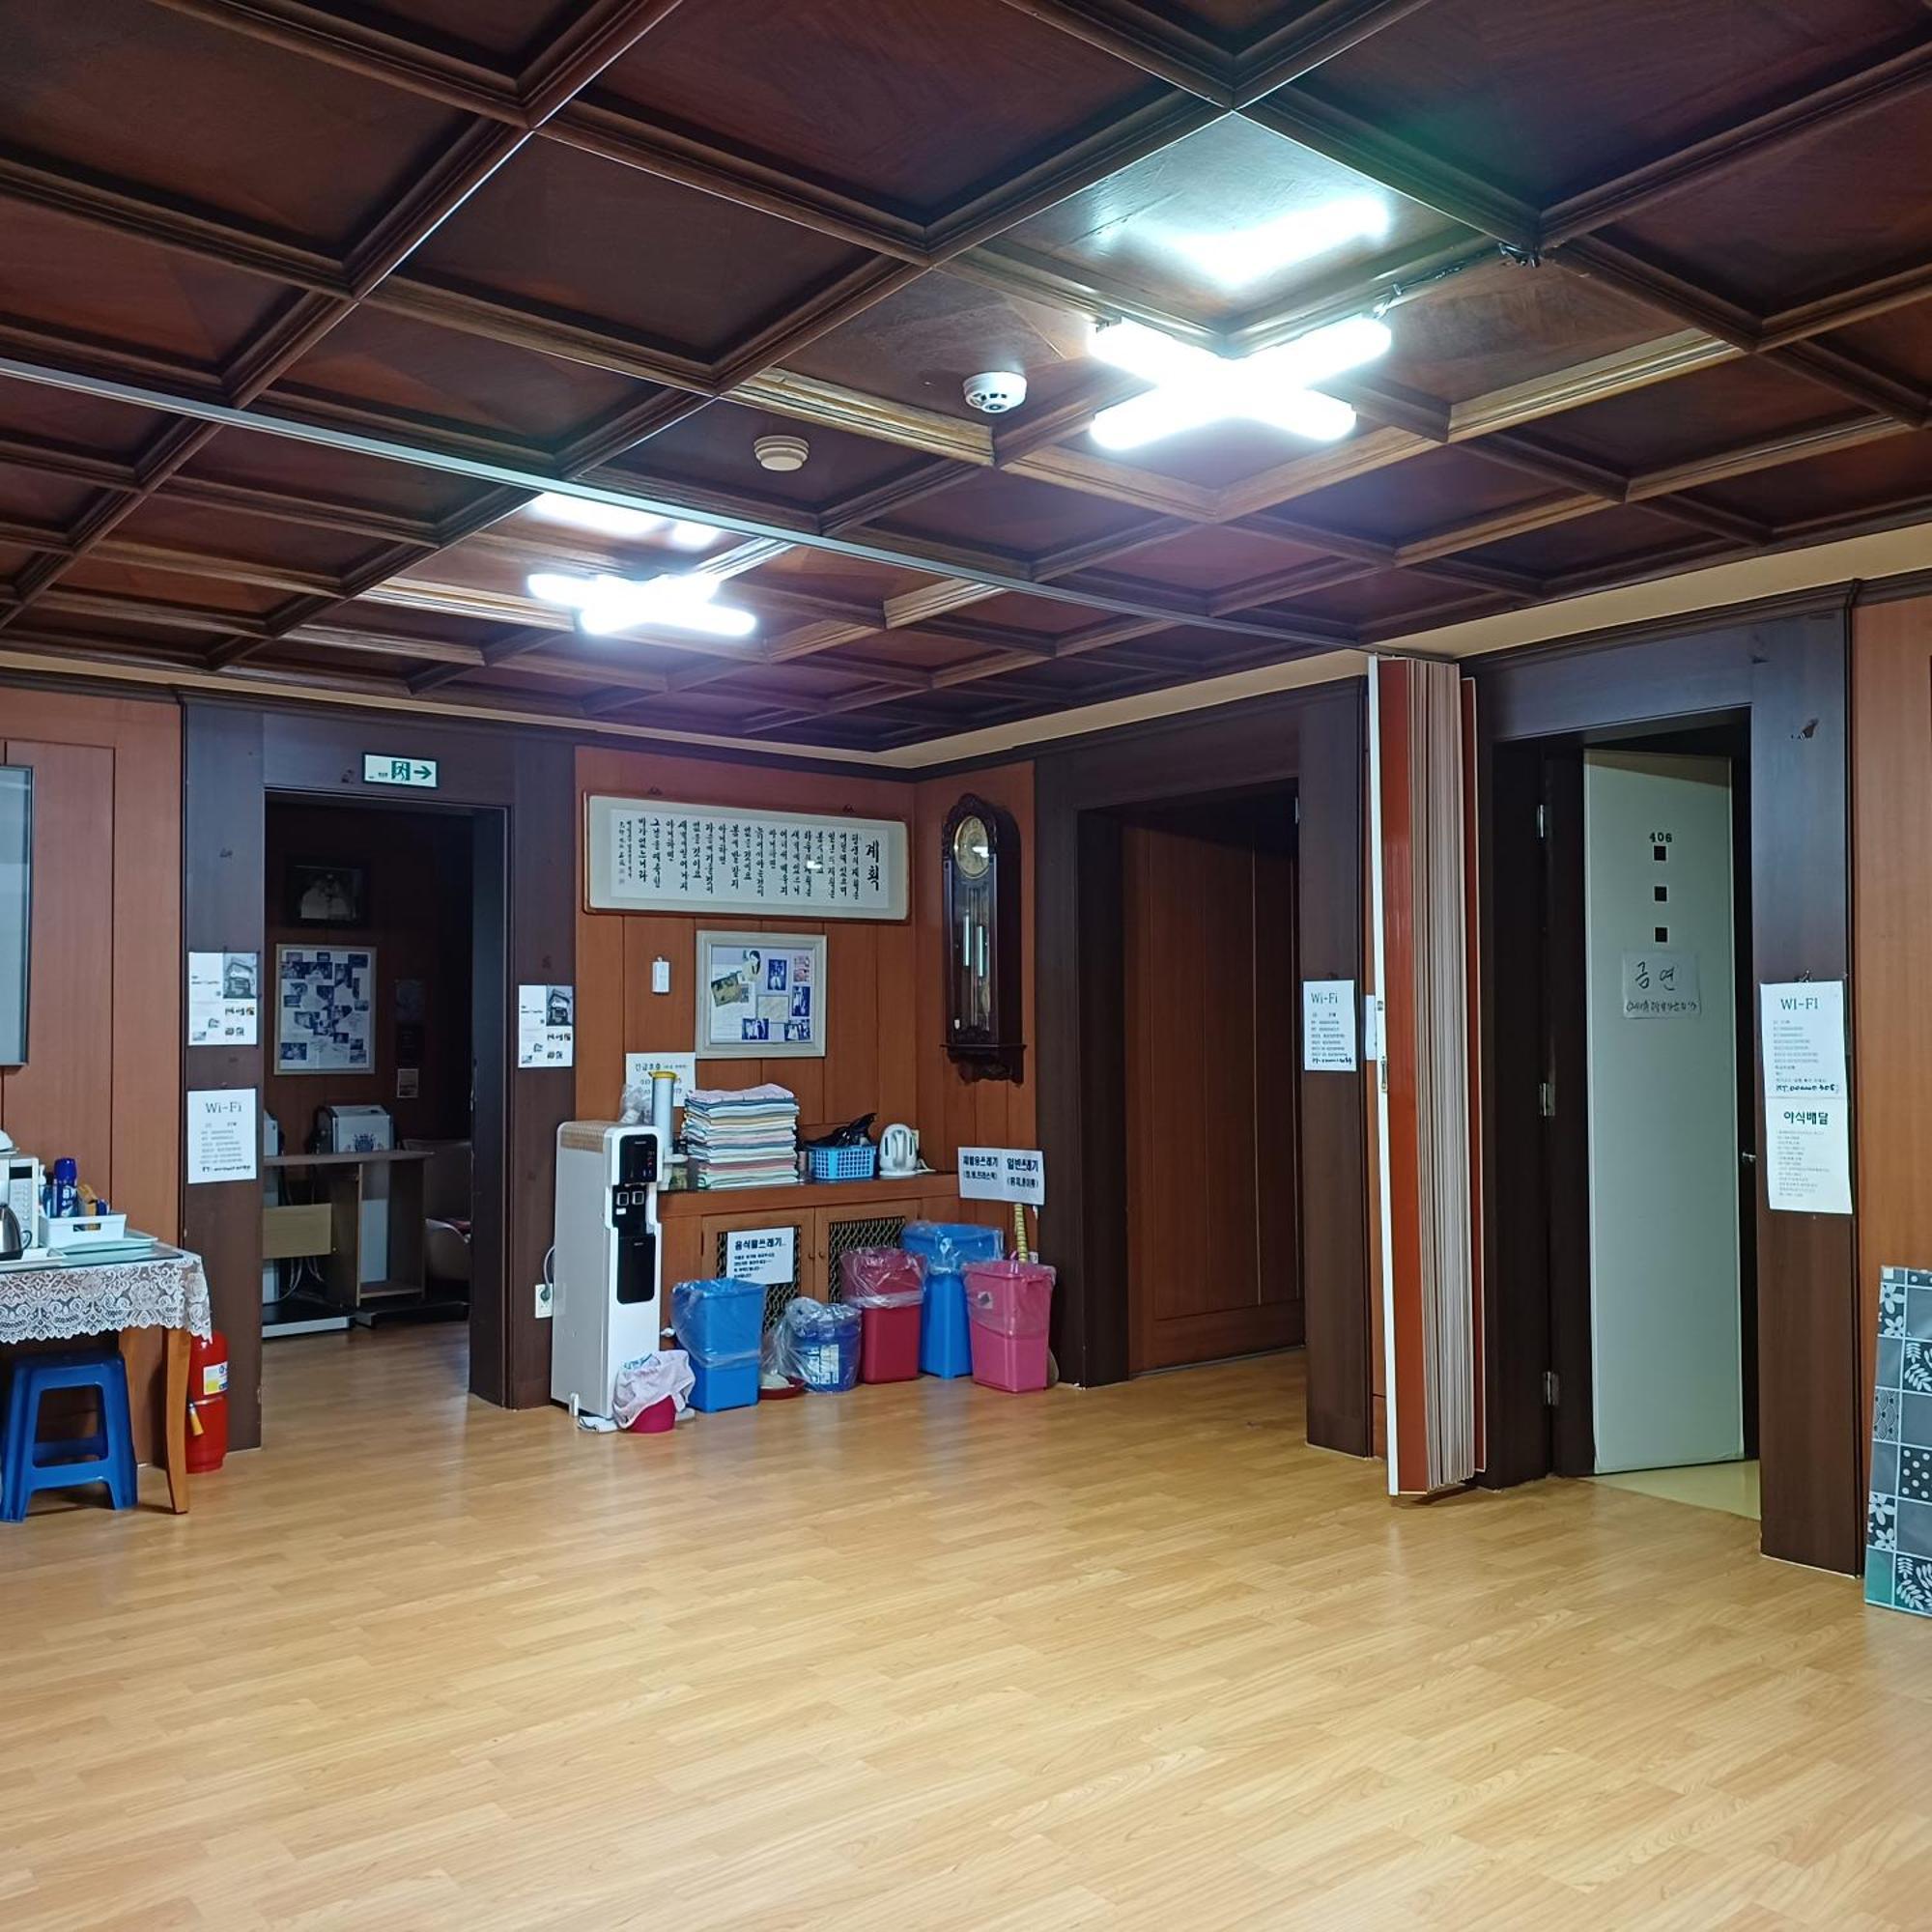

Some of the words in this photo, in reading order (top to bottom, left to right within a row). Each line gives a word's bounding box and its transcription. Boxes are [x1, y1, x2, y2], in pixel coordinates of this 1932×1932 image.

[1649, 832, 1672, 842] 406
[865, 838, 879, 892] 계획
[1310, 991, 1338, 1005] Wi-Fi
[205, 1101, 242, 1114] Wi-Fi
